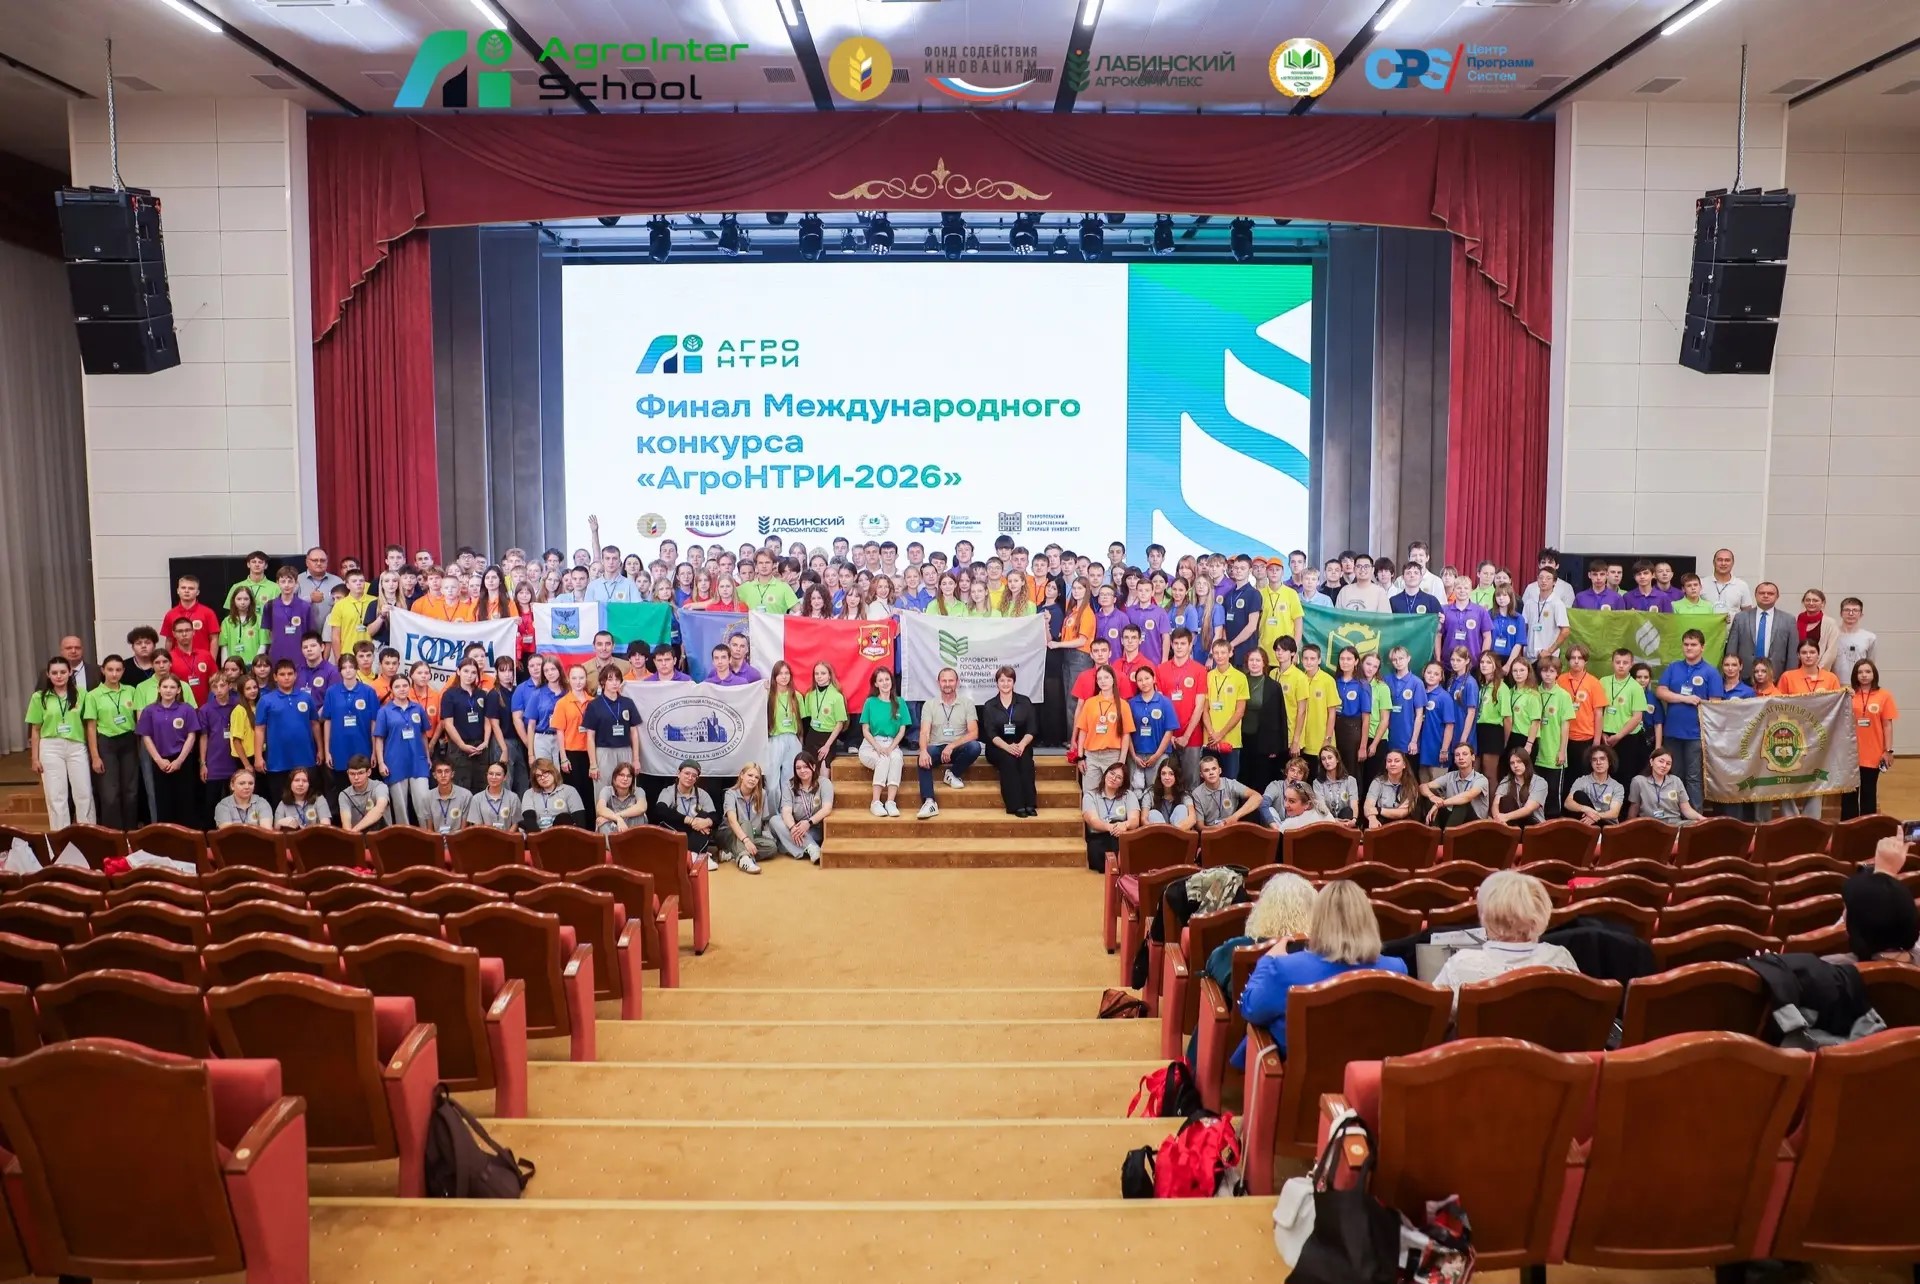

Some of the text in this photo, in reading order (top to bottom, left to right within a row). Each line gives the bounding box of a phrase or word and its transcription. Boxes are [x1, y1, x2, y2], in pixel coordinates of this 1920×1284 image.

[718, 339, 800, 352] АГРО
[717, 355, 799, 368] НТРИ
[636, 393, 1081, 425] Финал Международного
[637, 434, 804, 461] конкурса
[637, 464, 962, 495] «АгроНТРИ-2026»
[684, 520, 736, 528] ИННОВАЦИЯМ
[772, 515, 845, 526] ЛАБИНСКИЙ
[652, 736, 662, 747] DON
[663, 746, 679, 757] STATE
[711, 737, 740, 758] UNIVERSITY
